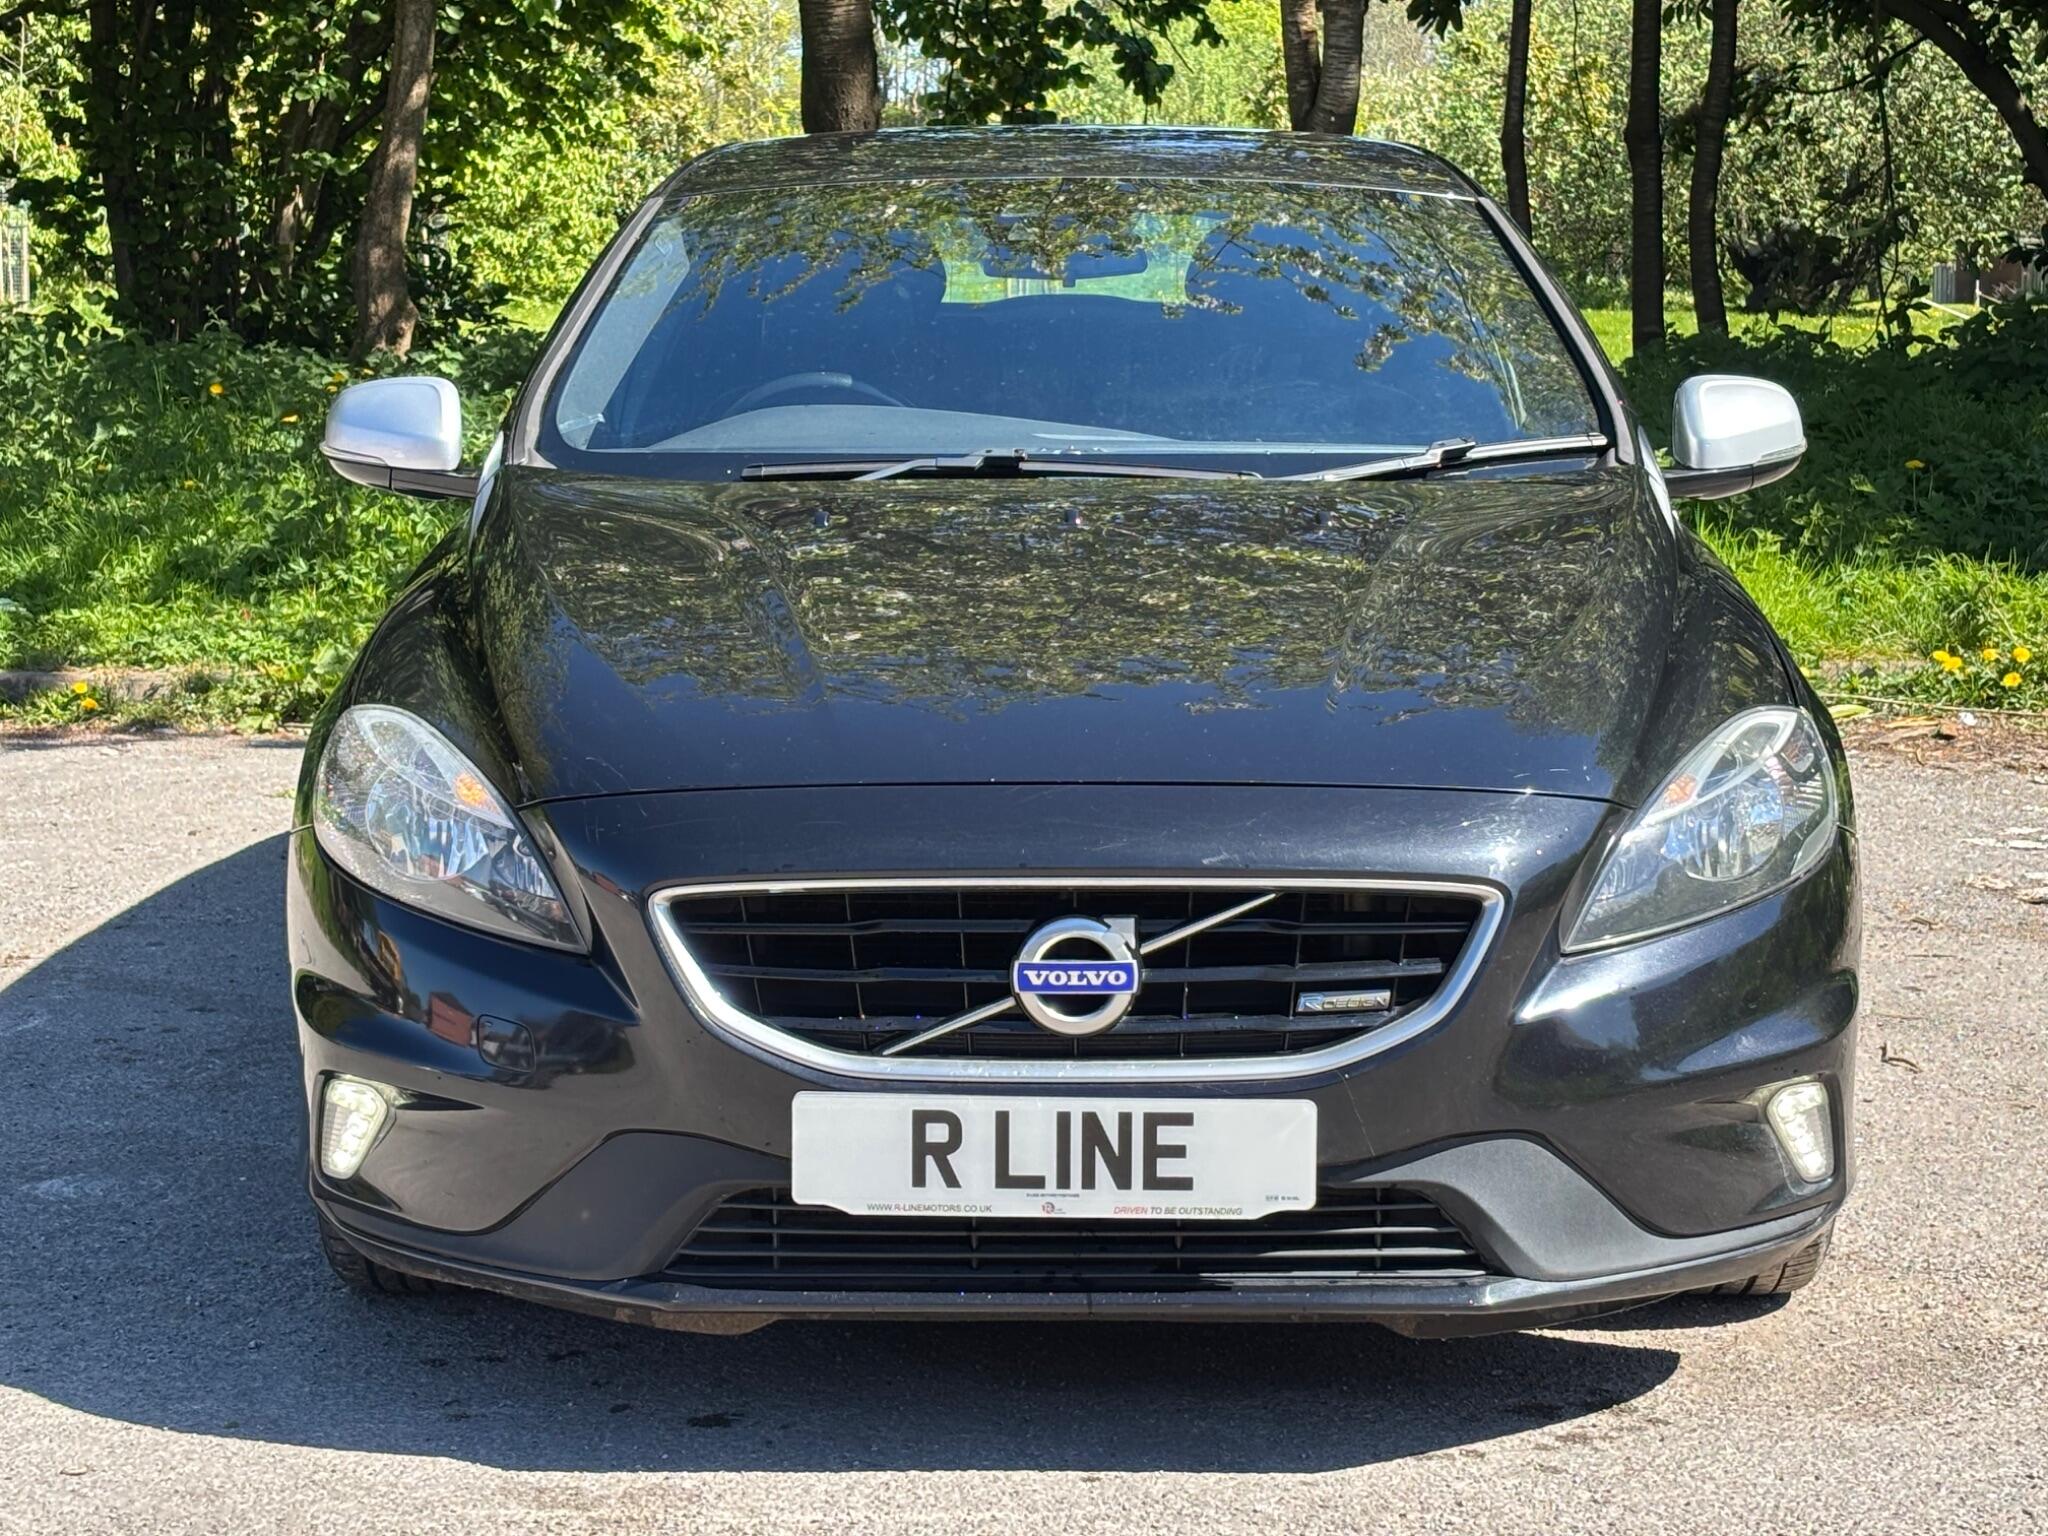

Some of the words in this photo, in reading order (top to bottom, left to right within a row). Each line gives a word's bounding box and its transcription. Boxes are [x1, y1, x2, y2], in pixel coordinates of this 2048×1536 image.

[1023, 970, 1127, 986] VOLVO
[912, 1110, 962, 1188] R
[995, 1110, 1194, 1190] LINE
[1113, 1206, 1148, 1215] DRIVEN
[1150, 1206, 1162, 1215] TO
[1164, 1206, 1177, 1215] BE
[1178, 1206, 1243, 1216] OUTSTANDING
